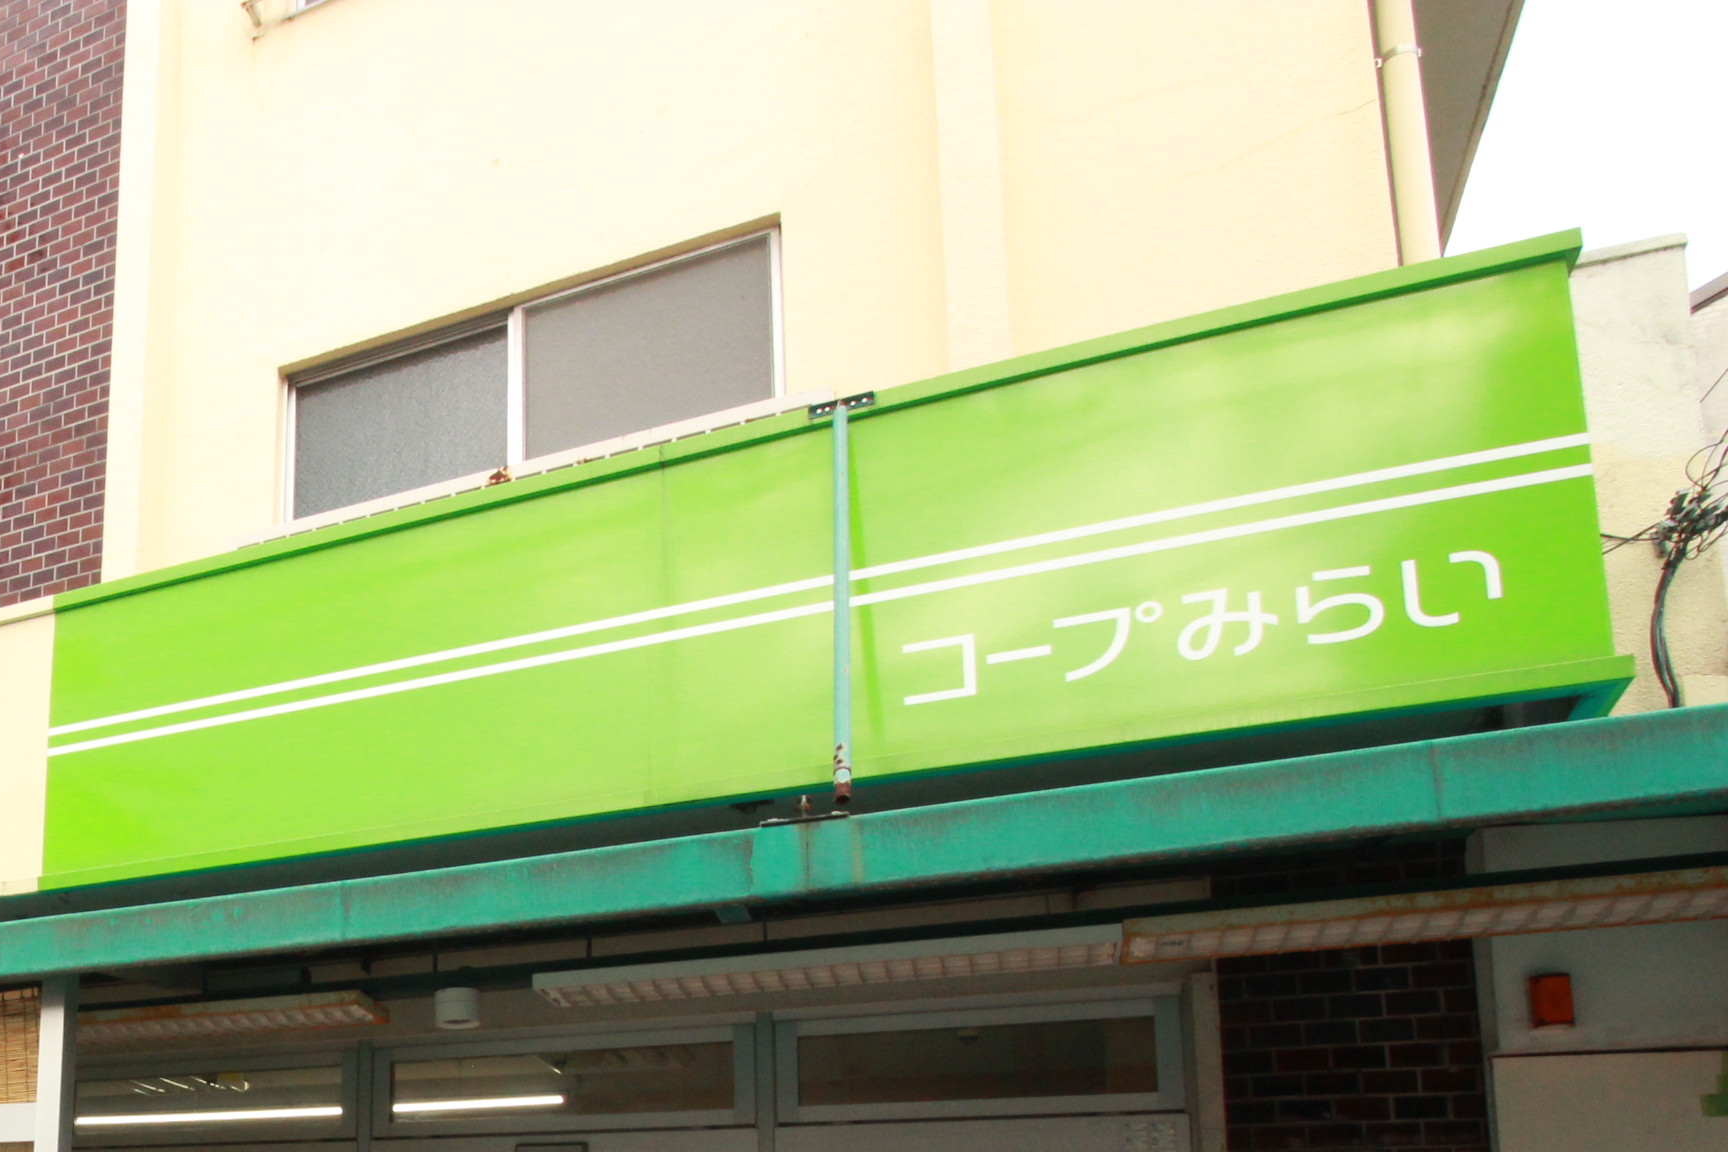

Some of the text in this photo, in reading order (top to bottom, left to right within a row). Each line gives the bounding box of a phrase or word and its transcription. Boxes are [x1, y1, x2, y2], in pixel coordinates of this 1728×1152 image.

[903, 549, 1503, 706] コープみらい
